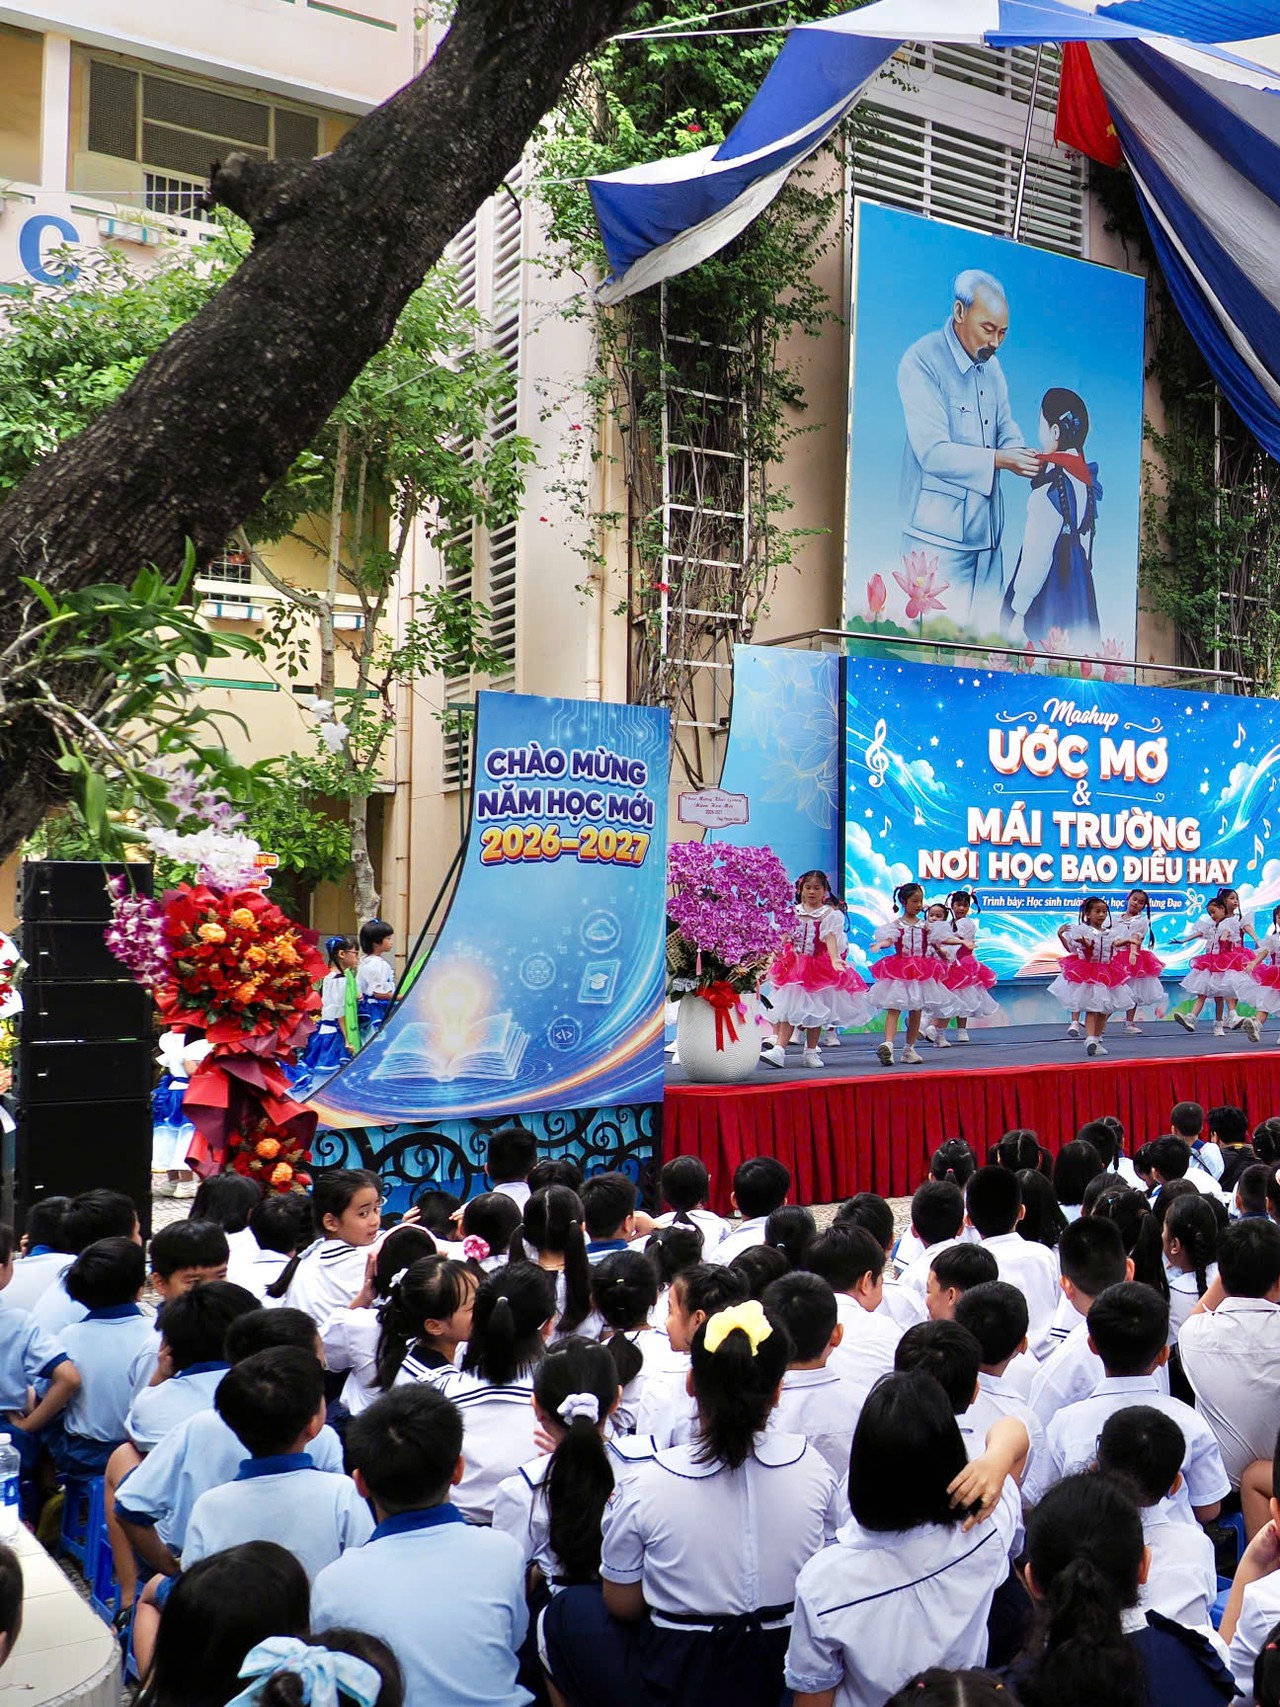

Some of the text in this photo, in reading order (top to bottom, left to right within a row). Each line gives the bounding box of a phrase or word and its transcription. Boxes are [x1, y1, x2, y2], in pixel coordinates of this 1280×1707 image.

[1043, 698, 1119, 733] Mashup
[485, 742, 647, 787] CHÀO MỪNG
[988, 723, 1168, 784] ƯỚC MƠ
[477, 783, 655, 826] NĂM HỌC MỚI
[1072, 780, 1093, 806] &
[967, 802, 1201, 852] MÁI TRƯỜNG
[918, 846, 1239, 889] NƠI HỌC BAO ĐIỀU HAY
[982, 896, 1005, 906] Trình
[1006, 896, 1025, 909] bày:
[1026, 896, 1043, 908] Học
[1044, 897, 1062, 907] sinh
[1110, 897, 1125, 909] học
[1167, 898, 1182, 910] Đạo
